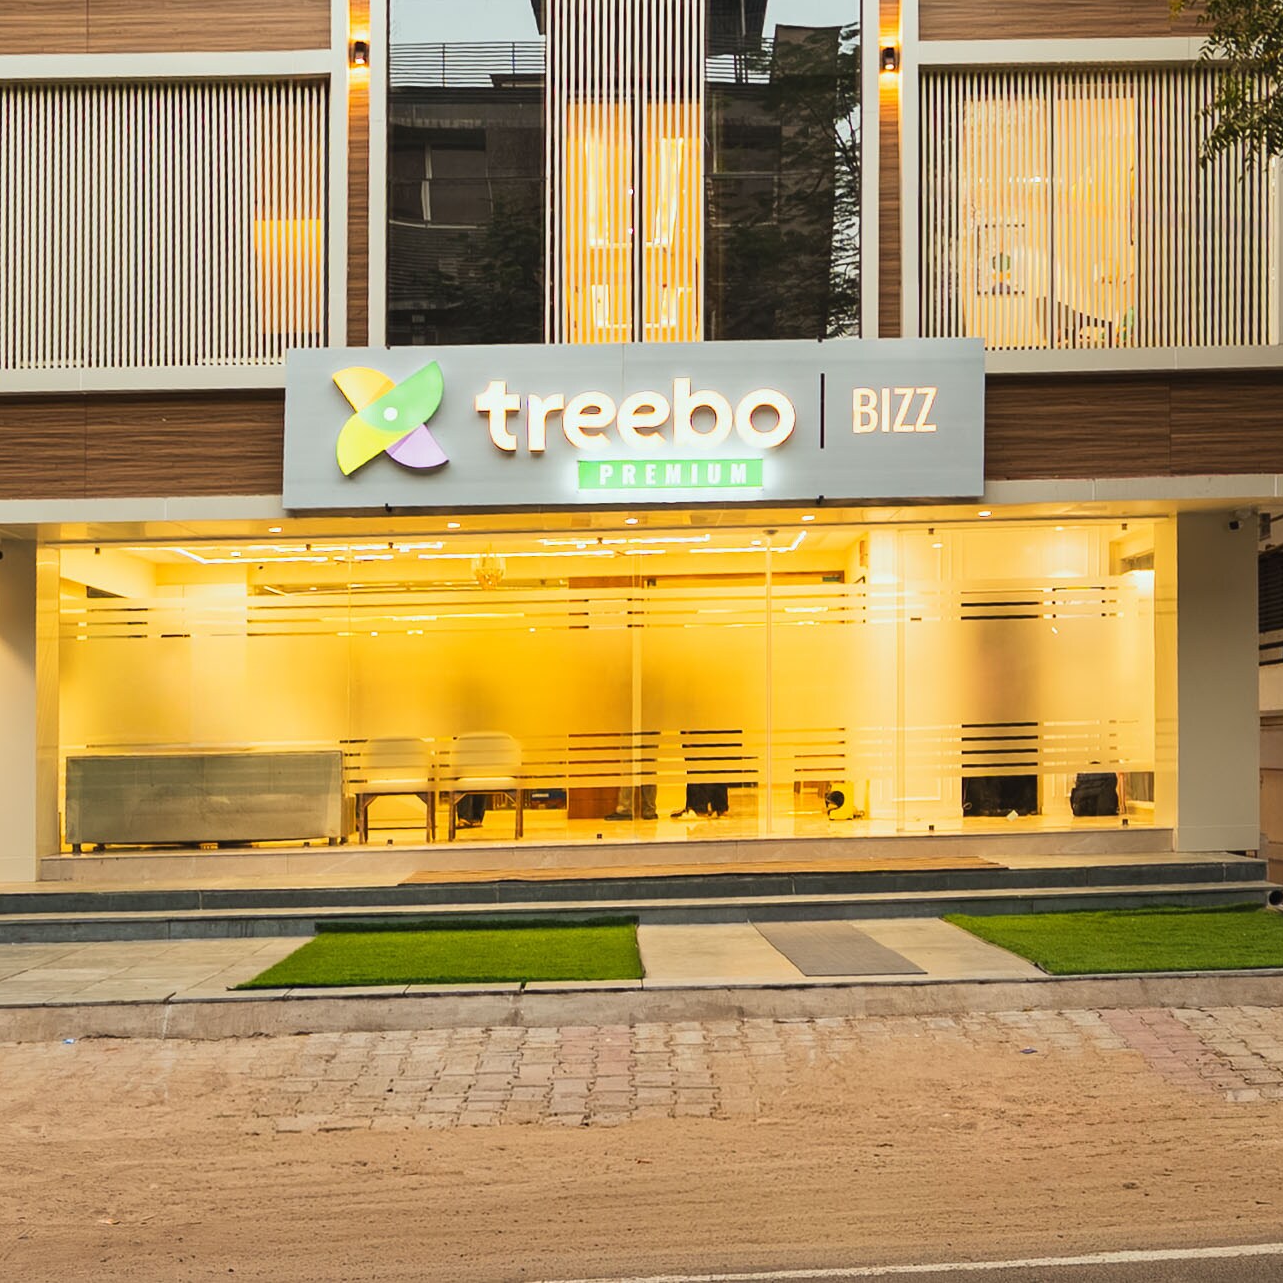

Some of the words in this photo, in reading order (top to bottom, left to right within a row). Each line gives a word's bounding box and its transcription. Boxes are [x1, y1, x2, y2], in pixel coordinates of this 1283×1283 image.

[474, 376, 797, 454] treebo
[851, 385, 938, 435] BIZZ
[598, 462, 748, 486] PREMIUM
